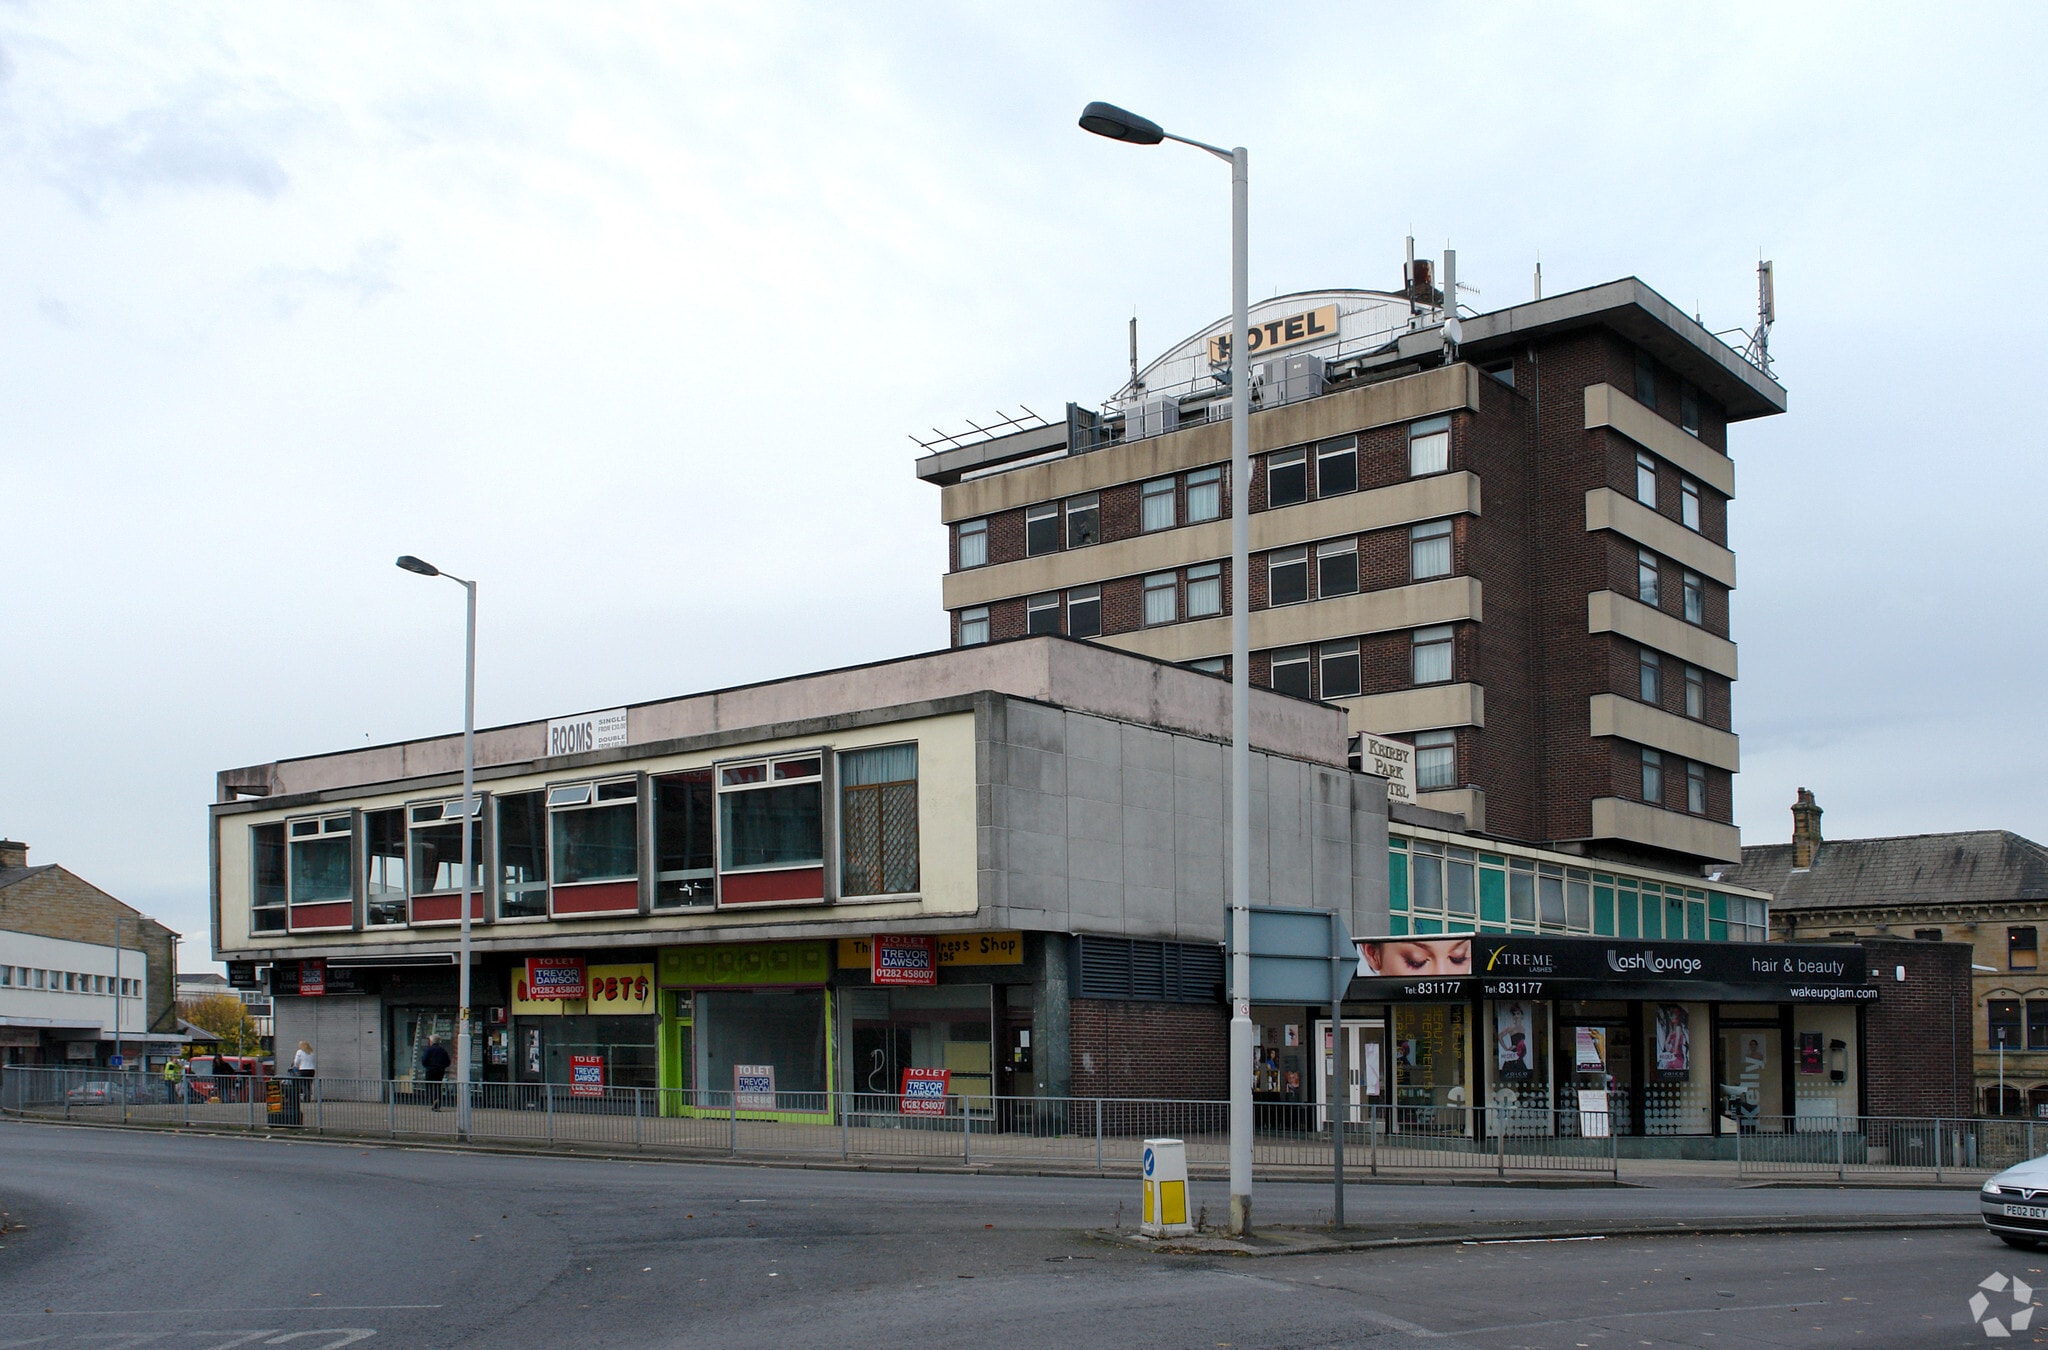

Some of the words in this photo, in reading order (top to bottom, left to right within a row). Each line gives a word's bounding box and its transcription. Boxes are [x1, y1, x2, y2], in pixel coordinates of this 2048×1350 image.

[1218, 312, 1325, 359] HOTEL
[598, 716, 626, 727] SINGLE
[552, 721, 593, 756] ROOMS
[598, 734, 626, 743] DOUBLE
[1374, 757, 1404, 780] PARK
[883, 935, 901, 943] TO
[903, 936, 926, 944] LET
[980, 936, 1016, 955] Shop
[882, 949, 928, 959] TREVOR
[1486, 945, 1553, 971] XTREME
[556, 957, 575, 965] LET
[882, 958, 929, 968] DAWSON
[1752, 957, 1778, 972] hair
[1783, 958, 1794, 973] &
[1798, 958, 1845, 976] beauty
[536, 969, 578, 977] TREVOR
[876, 969, 901, 978] 01282
[903, 970, 934, 979] 458007
[536, 976, 579, 984] DAWSON
[531, 986, 555, 994] 01282
[555, 985, 585, 994] 458007
[592, 975, 649, 1001] PETS
[1404, 986, 1417, 994] Tel:
[1417, 982, 1461, 994] 831177
[1484, 985, 1498, 994] Tel:
[1498, 982, 1543, 994] 831177
[1790, 987, 1878, 999] wakeupglam.com
[575, 1067, 600, 1075] TREVOR
[738, 1065, 751, 1075] TO
[753, 1066, 771, 1075] LET
[909, 1068, 924, 1076] TO
[926, 1069, 947, 1077] LET
[575, 1074, 600, 1082] DAWSON
[740, 1077, 769, 1086] TREVOR
[908, 1082, 943, 1091] TREVOR
[907, 1090, 942, 1099] DAWSON
[2006, 1205, 2028, 1217] PE02
[2029, 1208, 2047, 1219] DEY
